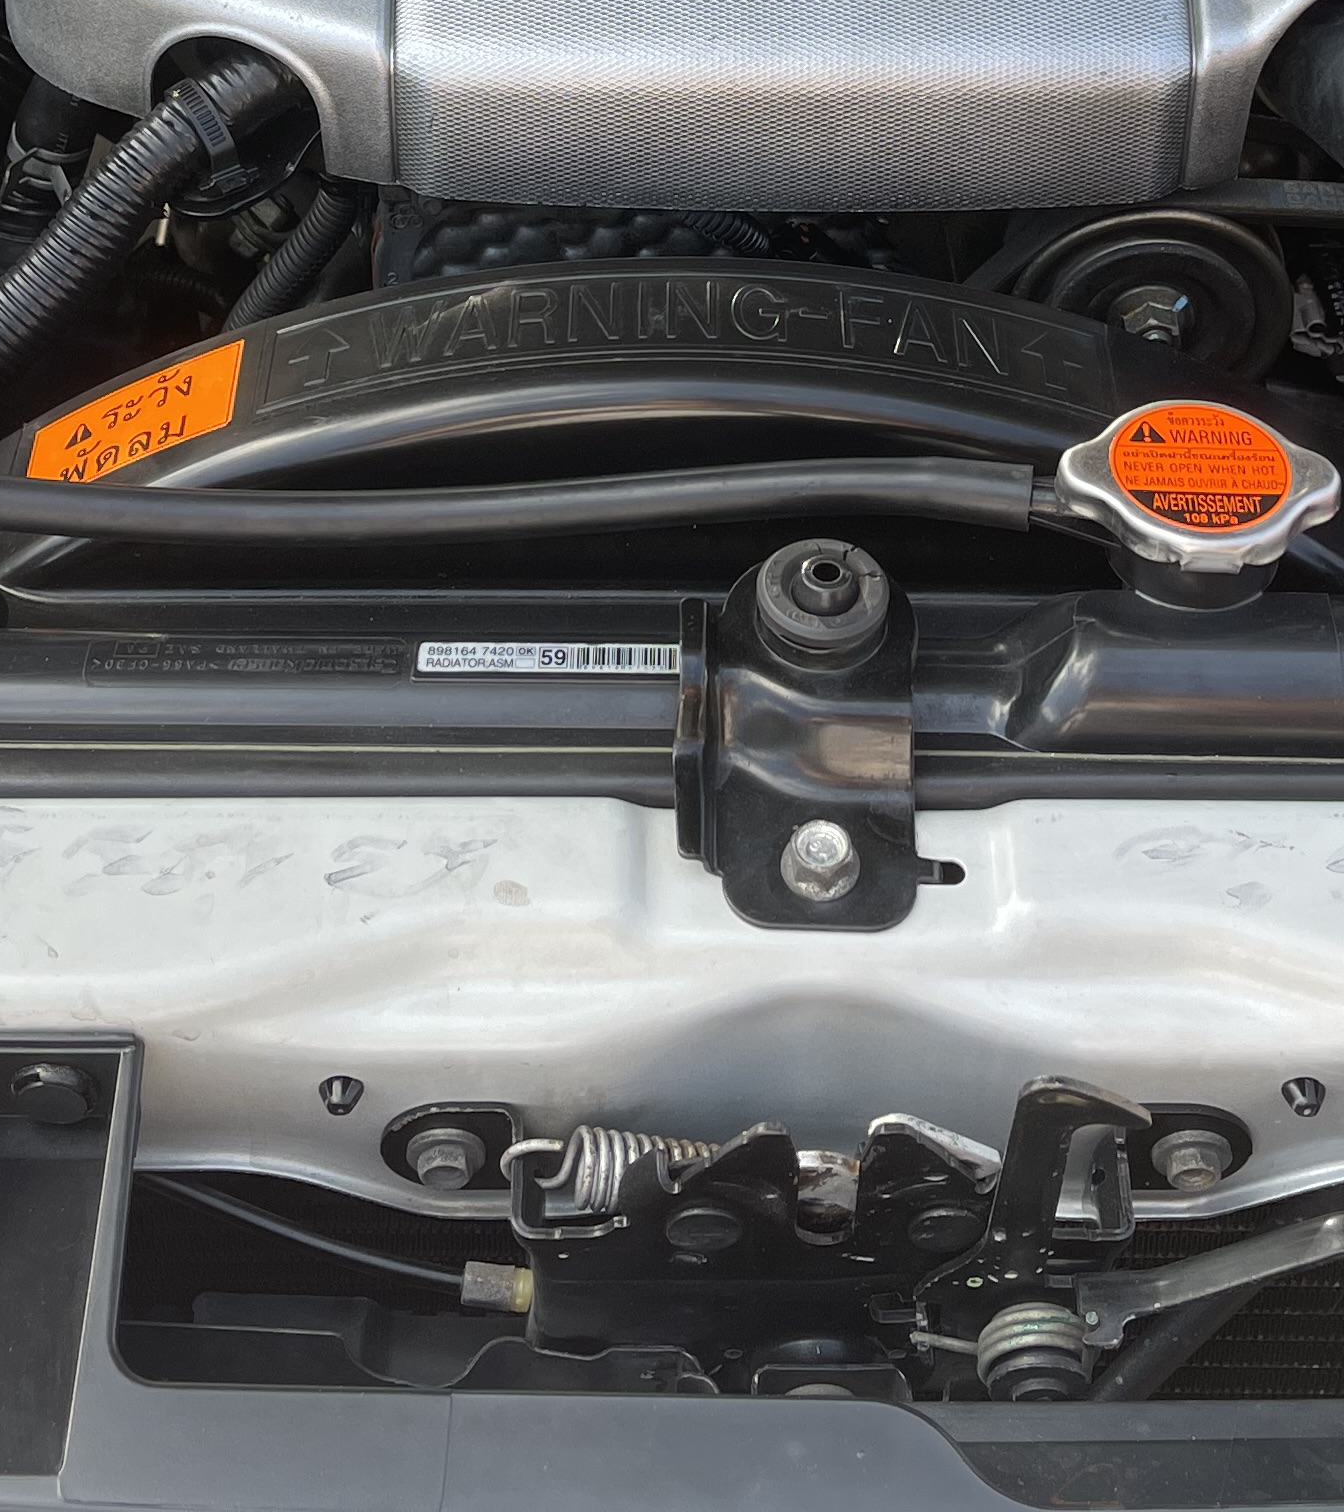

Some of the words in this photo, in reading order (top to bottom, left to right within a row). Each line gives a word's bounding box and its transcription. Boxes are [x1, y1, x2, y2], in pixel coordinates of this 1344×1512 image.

[102, 369, 193, 429] ระวัง
[1169, 429, 1252, 445] WARNING
[60, 415, 188, 481] พัดลม
[1123, 461, 1162, 473] NEVER
[1169, 462, 1202, 474] OPEN
[1209, 463, 1246, 475] WHEN
[1125, 475, 1140, 485] NE
[1143, 476, 1185, 487] JAMAIS
[1188, 477, 1227, 489] OUVRIR
[1153, 493, 1262, 514] AVERTISSEMENT
[1184, 512, 1208, 524] 108
[1212, 513, 1239, 525] kPa
[427, 646, 476, 656] 898164
[483, 646, 514, 656] 7420
[518, 647, 534, 656] OK
[541, 649, 567, 667] 59
